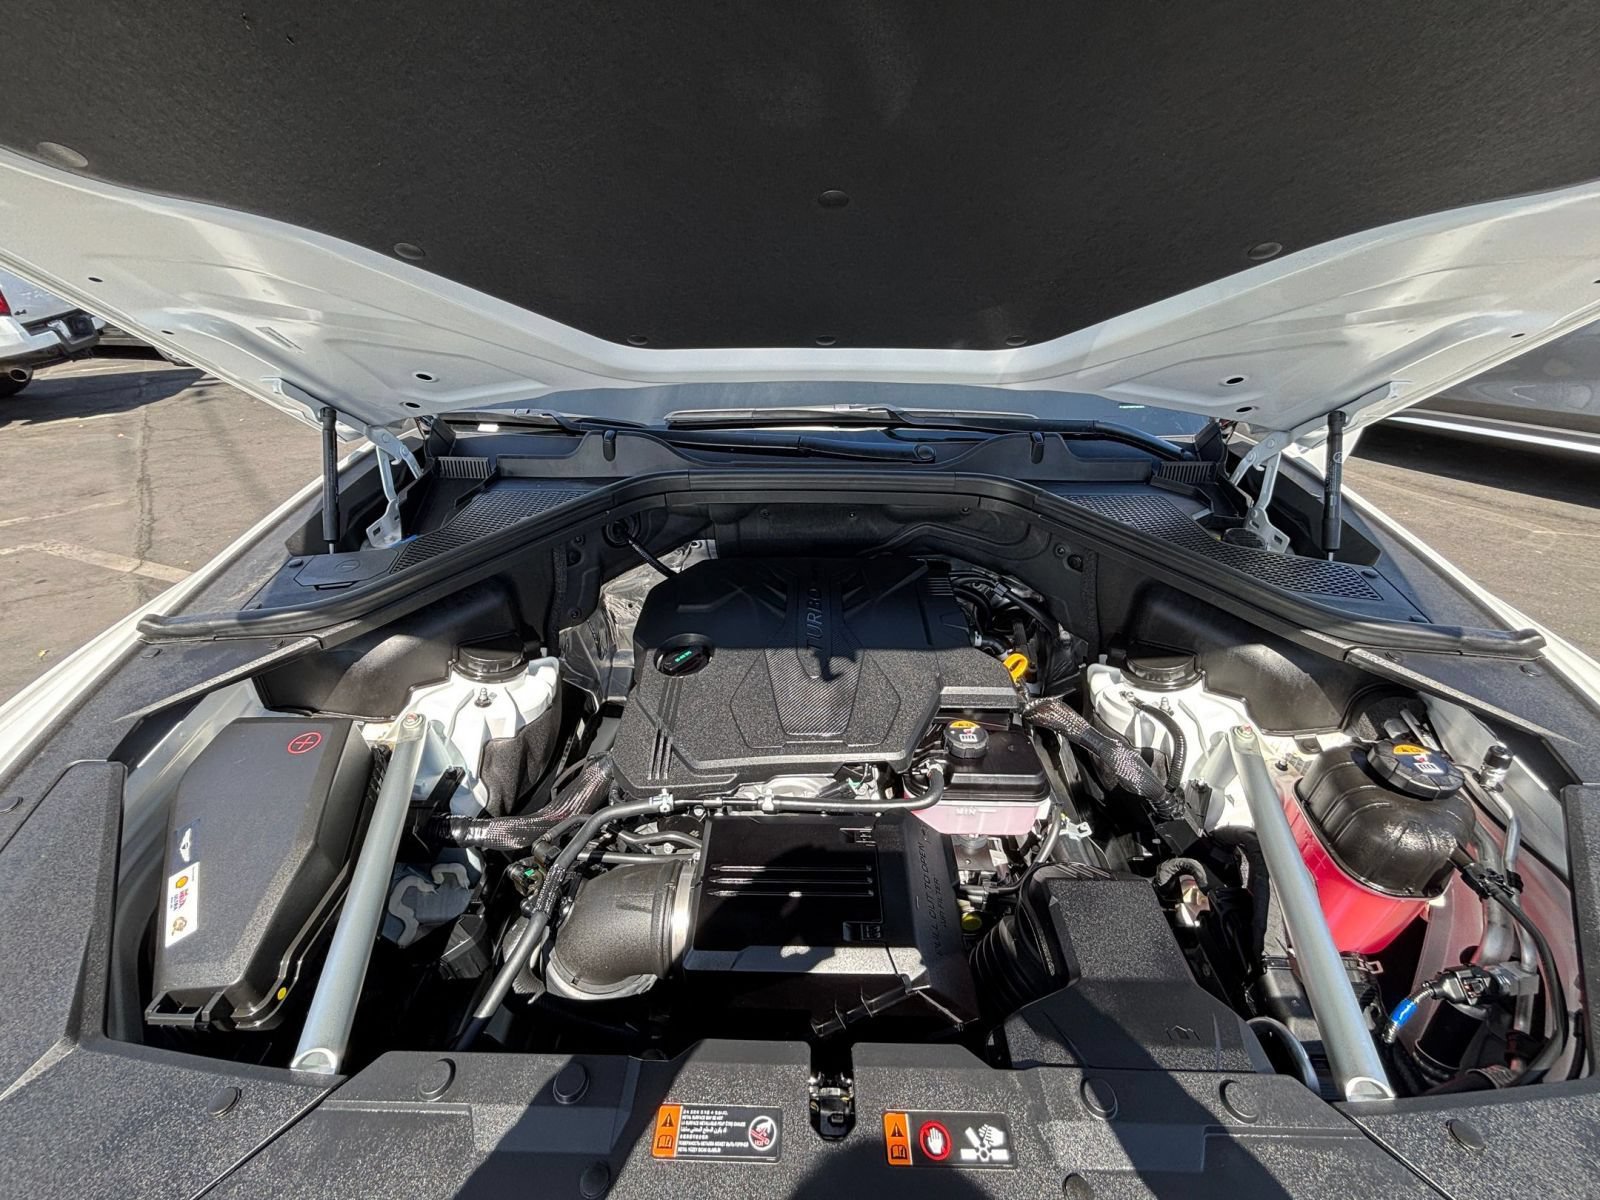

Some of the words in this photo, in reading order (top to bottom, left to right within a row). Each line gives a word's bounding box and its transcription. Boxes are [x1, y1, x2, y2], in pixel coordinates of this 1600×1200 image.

[806, 587, 824, 651] TURBO
[917, 842, 931, 873] OPEN
[924, 874, 933, 891] TO
[933, 877, 944, 908] FILTER
[926, 893, 938, 920] OUT
